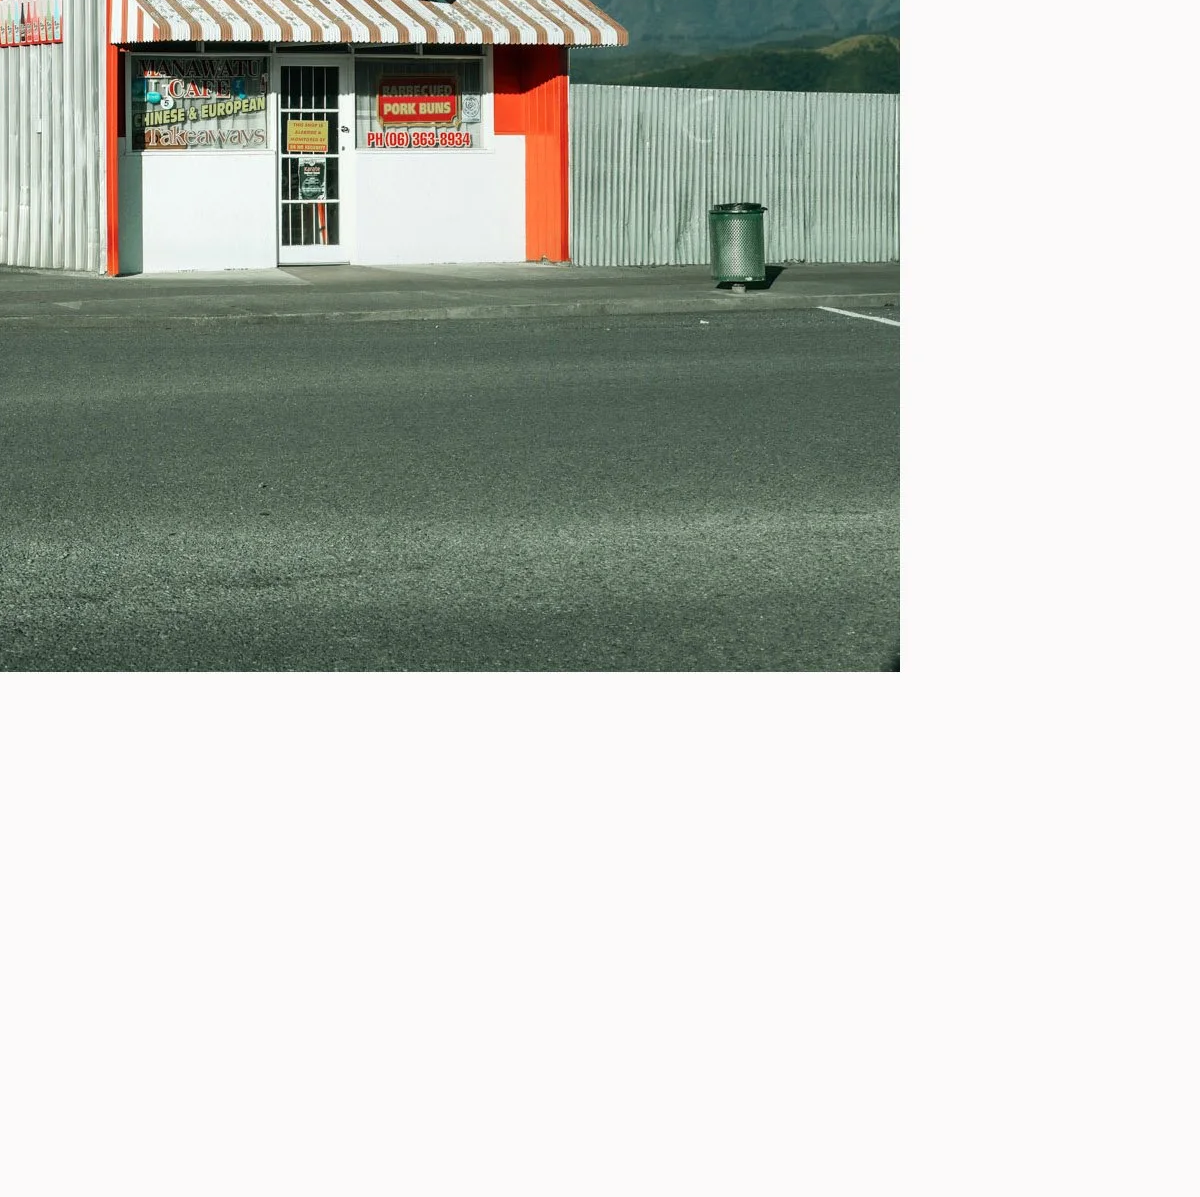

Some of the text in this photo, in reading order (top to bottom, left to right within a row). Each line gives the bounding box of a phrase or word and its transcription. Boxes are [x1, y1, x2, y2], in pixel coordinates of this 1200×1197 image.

[137, 59, 262, 79] MANAWATU
[169, 78, 231, 99] CAFE
[134, 97, 266, 128] CHINESE & EUROPEAN
[383, 102, 452, 115] PORK BUNS
[147, 125, 266, 148] Takeaways
[367, 131, 471, 147] PH (06) 363-8934
